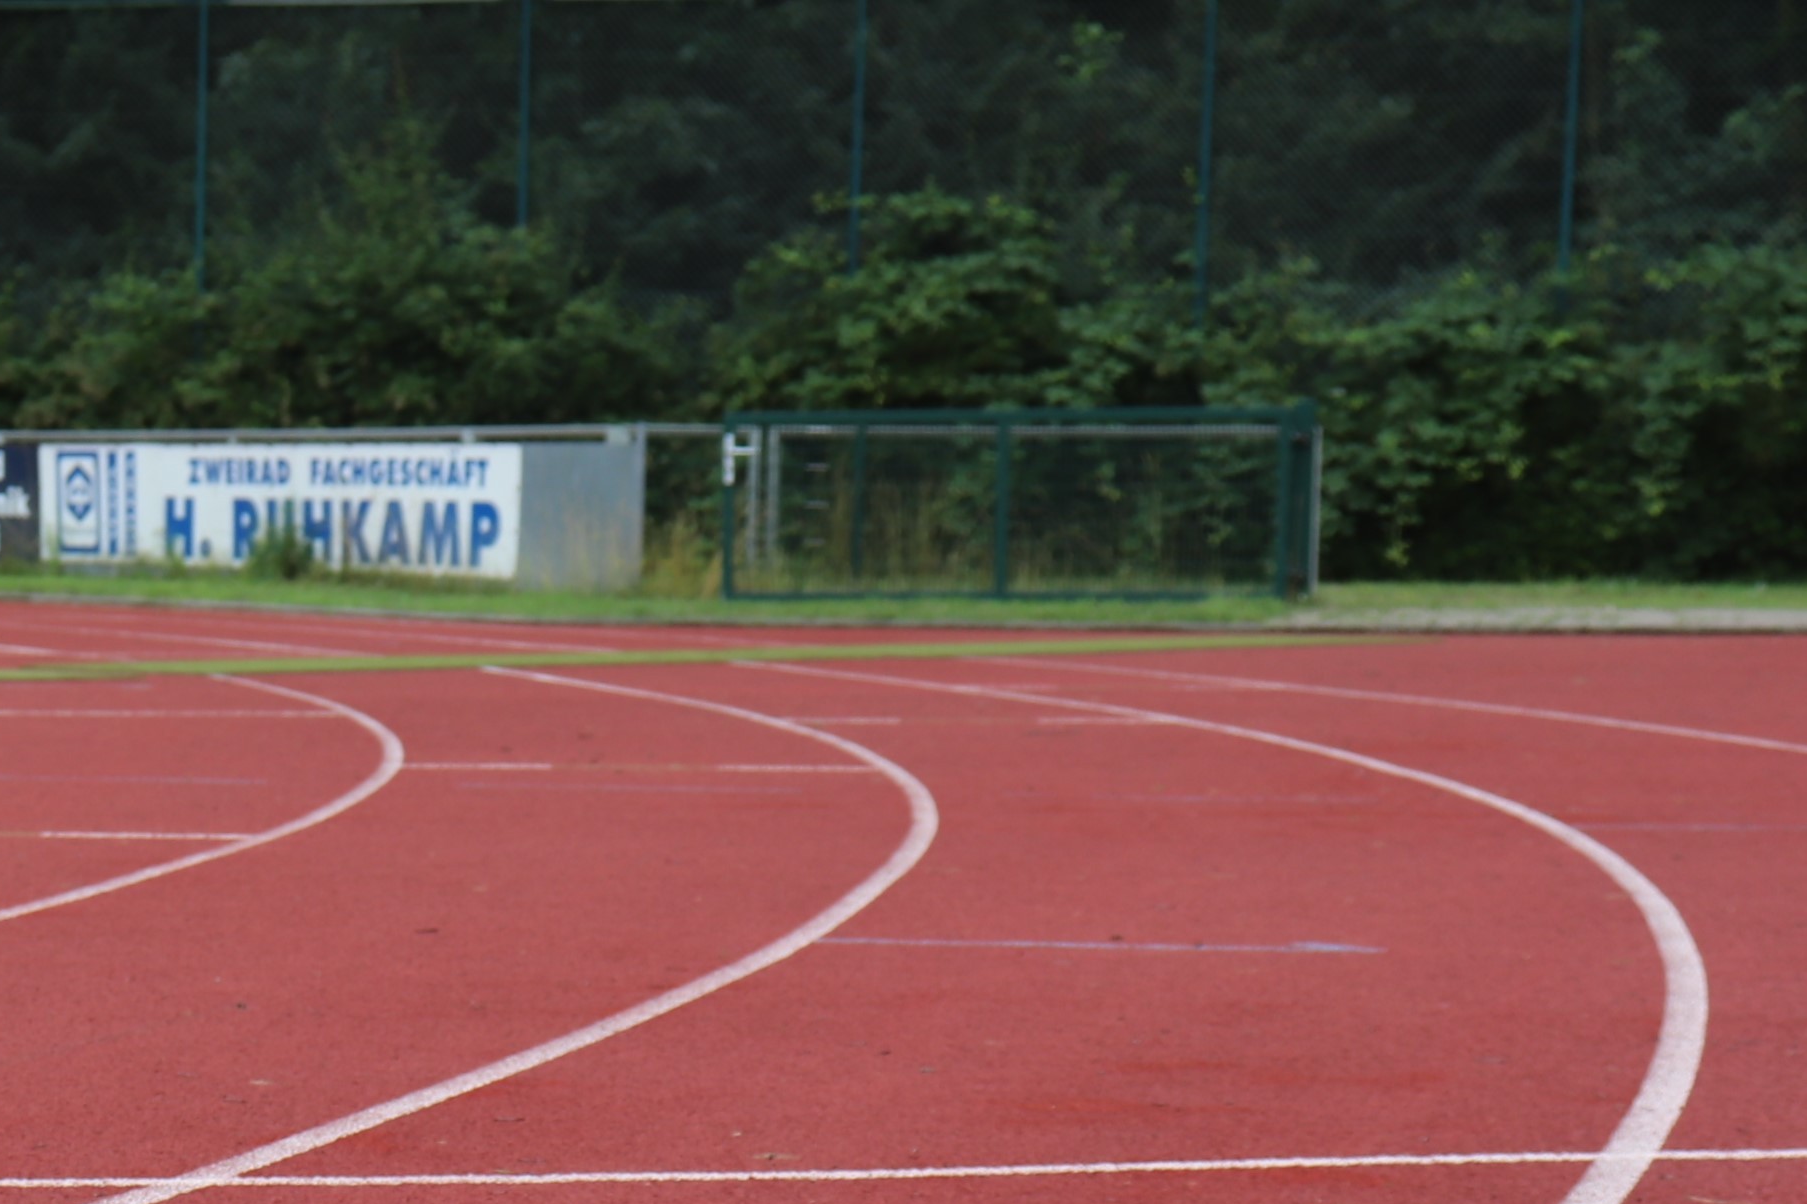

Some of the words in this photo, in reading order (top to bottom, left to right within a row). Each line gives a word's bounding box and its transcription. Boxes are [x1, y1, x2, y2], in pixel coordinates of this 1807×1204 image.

[188, 457, 291, 485] ZWEIRAD
[310, 450, 490, 487] FACHGESCHÄFT
[165, 498, 212, 559] H.
